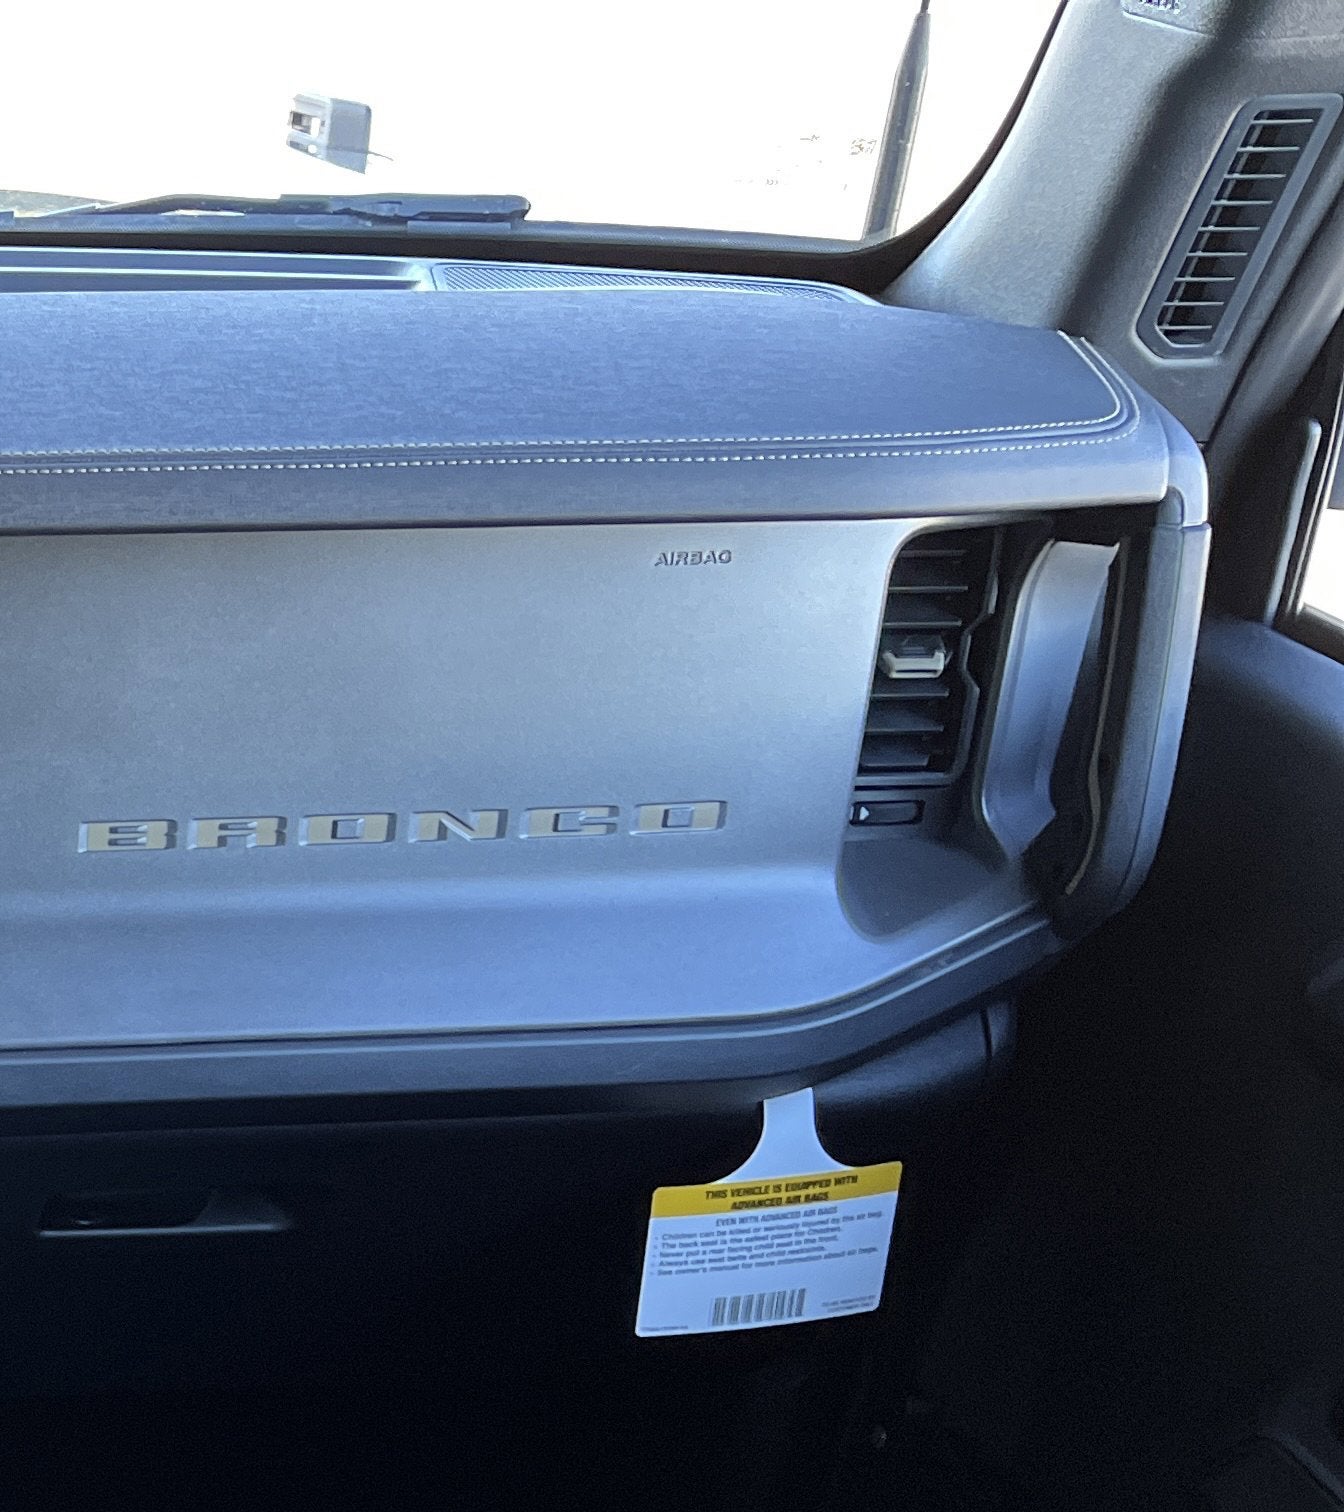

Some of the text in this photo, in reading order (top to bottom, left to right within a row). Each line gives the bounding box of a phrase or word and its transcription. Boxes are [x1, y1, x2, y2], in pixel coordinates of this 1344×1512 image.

[653, 549, 732, 567] AIRBAG
[78, 800, 728, 854] BRONCO
[730, 1184, 770, 1198] VEHICLE
